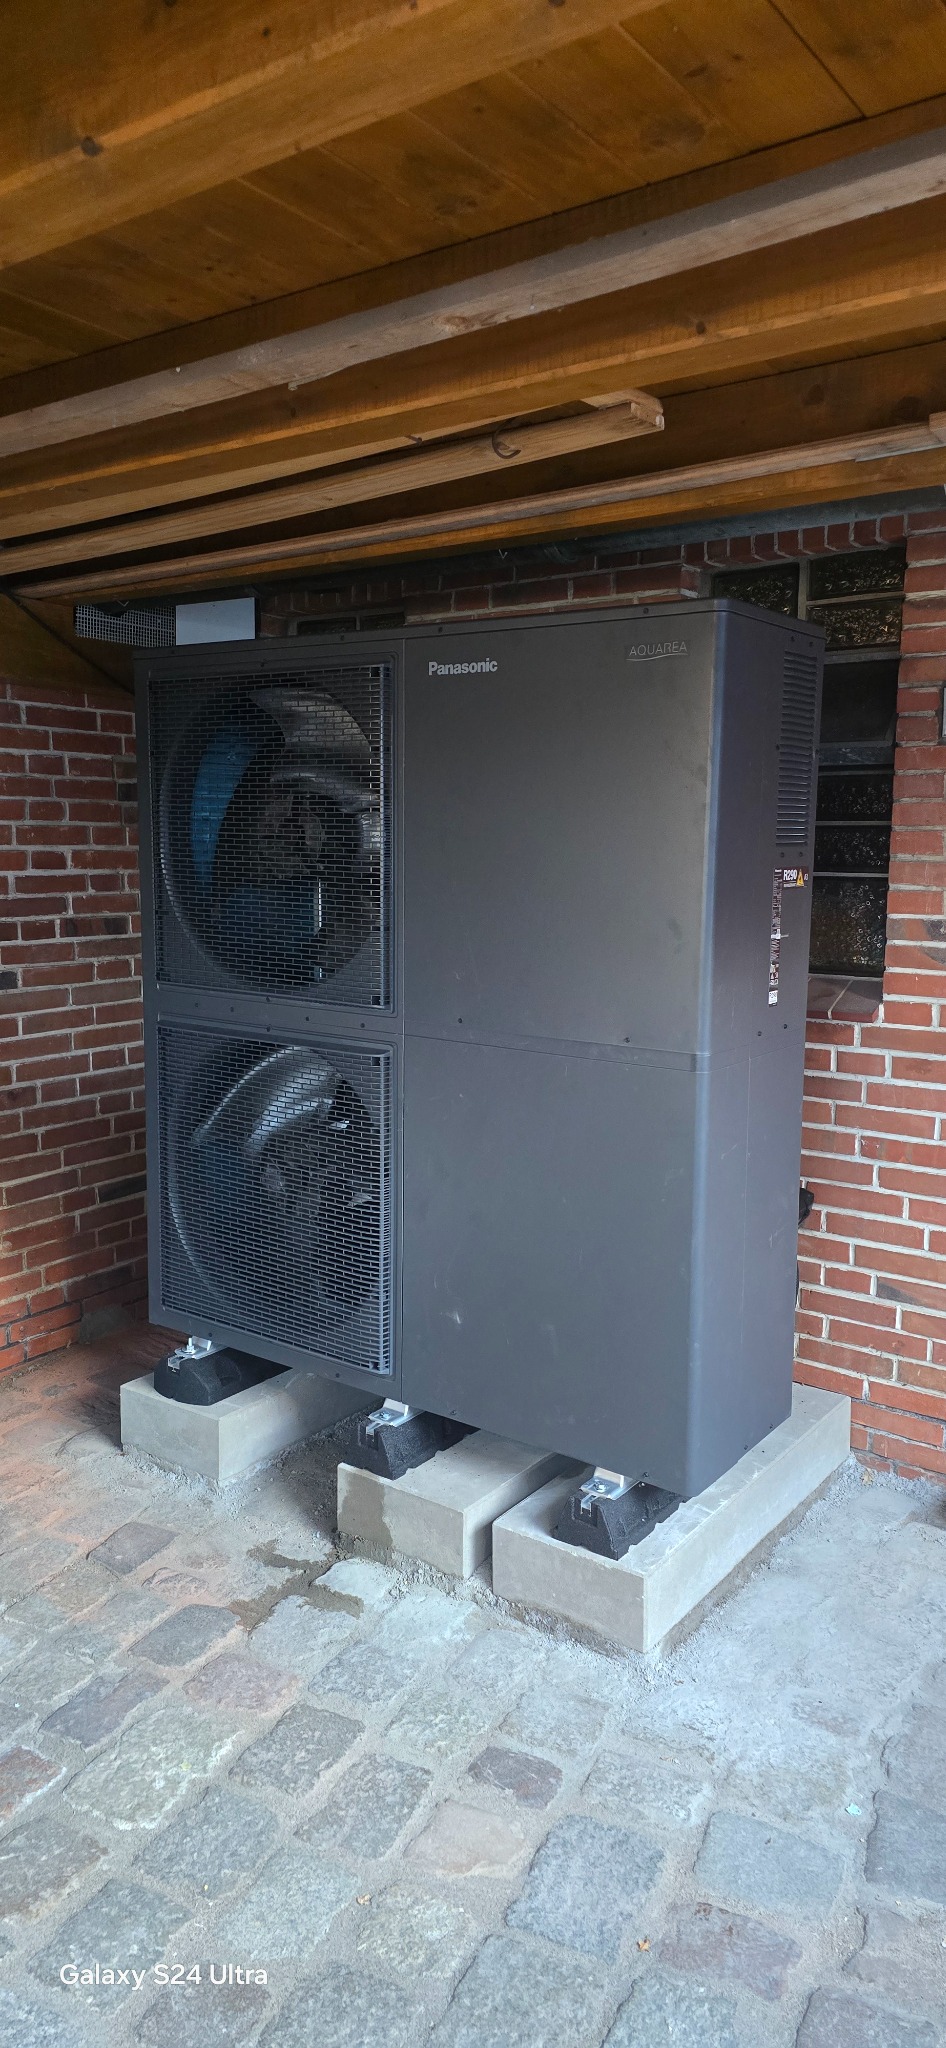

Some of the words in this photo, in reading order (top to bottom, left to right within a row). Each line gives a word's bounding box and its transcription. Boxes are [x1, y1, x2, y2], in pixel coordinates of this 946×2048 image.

[628, 641, 688, 656] AQUAREA
[428, 658, 498, 675] Panasonic
[783, 869, 798, 881] R290
